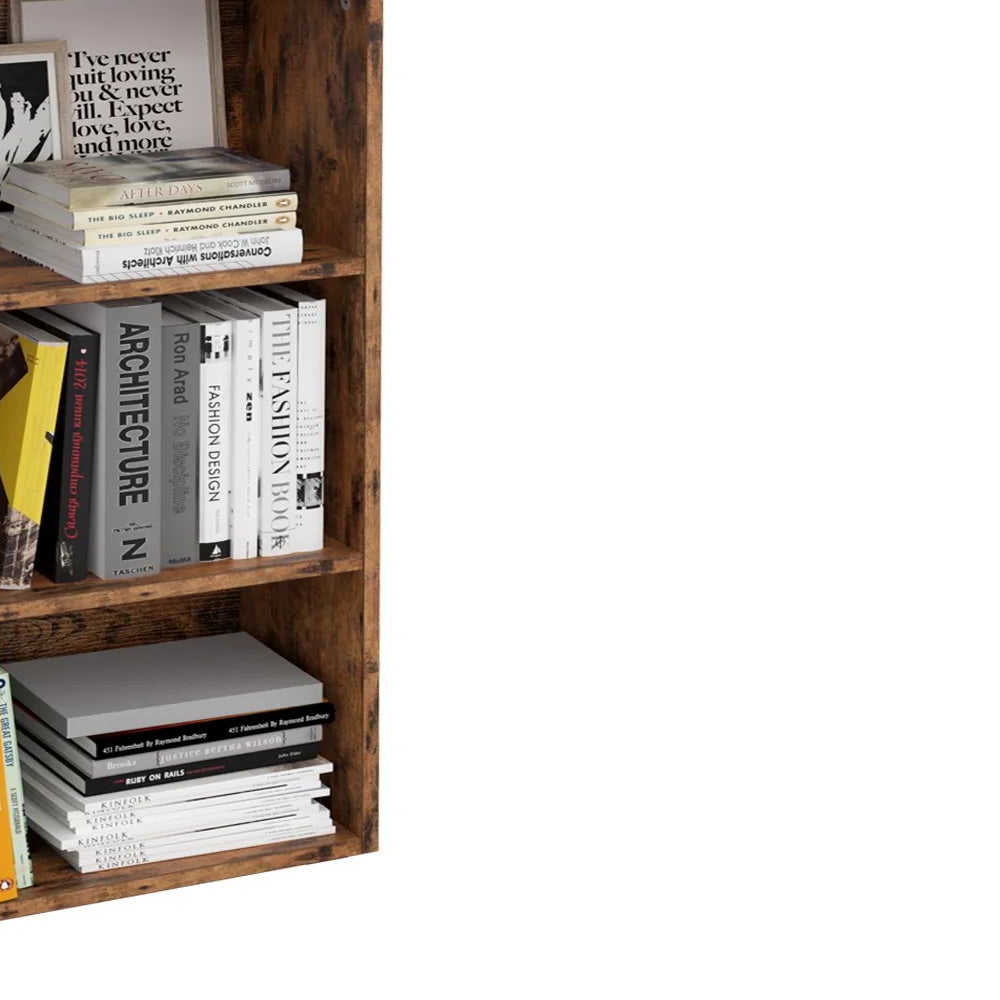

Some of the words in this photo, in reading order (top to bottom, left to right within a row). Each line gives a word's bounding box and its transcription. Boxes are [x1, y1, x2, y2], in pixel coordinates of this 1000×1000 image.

[114, 50, 171, 65] never
[110, 65, 175, 85] loving
[72, 90, 93, 103] ou
[99, 83, 121, 101] &
[126, 84, 182, 99] never
[73, 103, 102, 120] ill.
[108, 100, 183, 120] Expect
[72, 121, 119, 138] love,
[124, 118, 171, 134] love,
[74, 136, 112, 155] and
[117, 136, 173, 151] more
[120, 186, 164, 200] AFTER
[168, 184, 204, 197] DAYS
[129, 211, 155, 219] SLEEP
[167, 206, 216, 216] RAYMOND
[219, 201, 268, 211] CHANDLER
[137, 228, 161, 236] SLEEP
[173, 223, 219, 233] RAYMOND
[222, 218, 268, 228] CHANDLER
[164, 243, 198, 254] Heinrich
[200, 241, 216, 249] and
[252, 236, 270, 245] John
[122, 255, 173, 270] Architects
[176, 254, 198, 266] with
[201, 246, 272, 262] Conversations
[272, 313, 291, 365] THE
[173, 333, 190, 364] Ron
[73, 359, 88, 390] 2014
[173, 368, 190, 404] Arad
[72, 394, 84, 428] книга
[118, 322, 150, 507] ARCHITECTURE
[208, 385, 221, 446] FASHION
[271, 371, 291, 475] FASHION
[208, 450, 221, 502] DESIGN
[64, 498, 80, 540] Самая
[121, 538, 147, 561] N
[113, 565, 154, 576] TASCHEN
[0, 702, 9, 716] THE
[0, 717, 11, 739] GREAT
[228, 726, 239, 734] 451
[240, 722, 269, 732] Fahrenheit
[279, 716, 304, 726] Raymond
[306, 713, 330, 722] Bradbury
[103, 746, 113, 754] 451
[115, 742, 144, 752] Fahrenheit
[155, 736, 181, 746] Raymond
[182, 732, 208, 741] Bradbury
[3, 740, 15, 767] GATSBY
[107, 760, 137, 770] Brooks
[125, 775, 147, 785] RUBY
[148, 773, 161, 782] ON
[163, 769, 186, 779] RAILS
[101, 795, 152, 809] KINFOLK
[86, 812, 137, 825] KINFOLK
[91, 818, 144, 831] KINFOLK
[78, 832, 128, 846] KINFOLK
[96, 843, 146, 856] KINFOLK
[96, 851, 146, 864] KINFOLK
